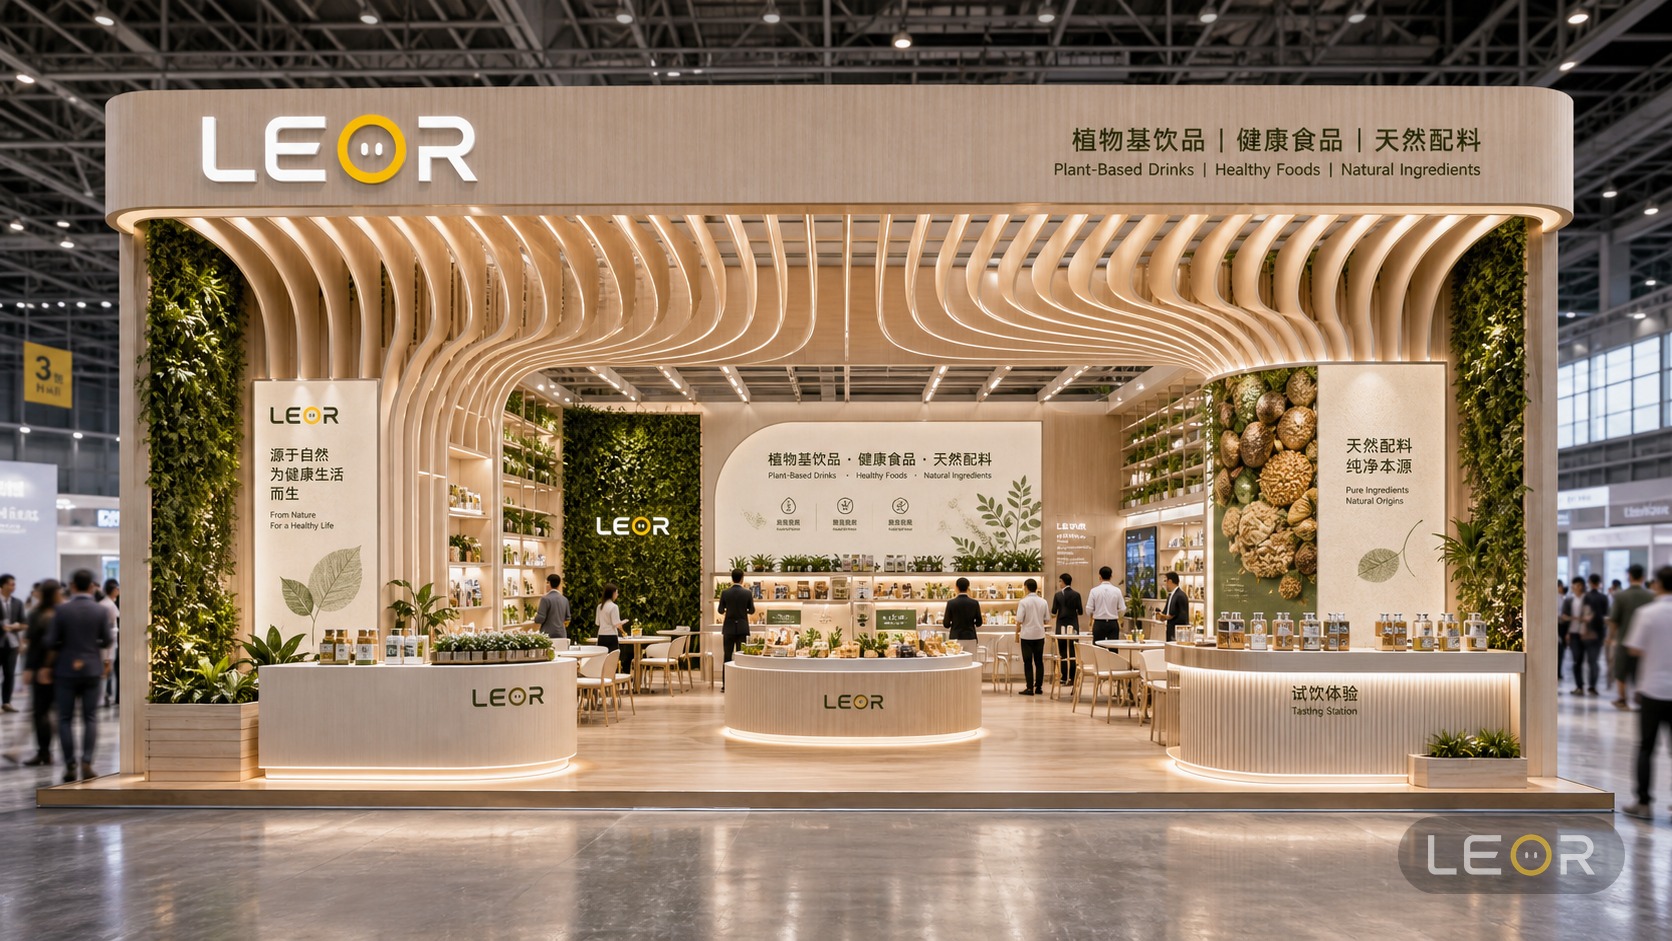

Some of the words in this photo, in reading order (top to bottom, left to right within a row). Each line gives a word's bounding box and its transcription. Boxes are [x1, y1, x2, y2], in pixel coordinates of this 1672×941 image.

[1071, 127, 1205, 153] 植物基饮品
[1236, 126, 1343, 153] 健康食品
[1375, 127, 1482, 153] 天然配料
[201, 113, 478, 184] LEOR
[1054, 162, 1143, 177] Plant-Based
[1148, 162, 1195, 176] Drinks
[1215, 162, 1271, 180] Healthy
[1276, 162, 1321, 177] Foods
[1341, 162, 1394, 177] Natural
[1400, 162, 1481, 180] Ingredients
[269, 406, 339, 425] LEOR
[1346, 437, 1413, 454] 天然配料
[270, 447, 329, 463] 源于自然
[767, 451, 841, 467] 植物基饮品
[857, 451, 916, 467] 健康食品
[933, 451, 992, 467] 天然配料
[270, 466, 344, 482] 为健康生活
[1346, 458, 1412, 475] 纯净本源
[768, 471, 812, 480] Plant-Based
[813, 471, 837, 480] Drinks
[856, 471, 884, 481] Healthy
[885, 471, 908, 480] Foods
[923, 471, 951, 480] Natural
[951, 471, 992, 482] Ingredients
[270, 485, 300, 501] 而生
[1345, 486, 1364, 495] Pure
[1365, 486, 1410, 496] Ingredients
[1345, 497, 1375, 505] Natural
[1375, 496, 1404, 507] Origins
[269, 510, 290, 519] From
[290, 511, 317, 519] Nature
[269, 521, 283, 530] For
[290, 521, 319, 531] Healthy
[320, 521, 335, 530] Life
[596, 516, 670, 536] LEOR
[472, 686, 544, 707] LEOR
[1292, 685, 1358, 702] 试饮体验
[823, 694, 884, 710] LEOR
[1291, 706, 1324, 718] Tasting
[1326, 706, 1358, 716] Station
